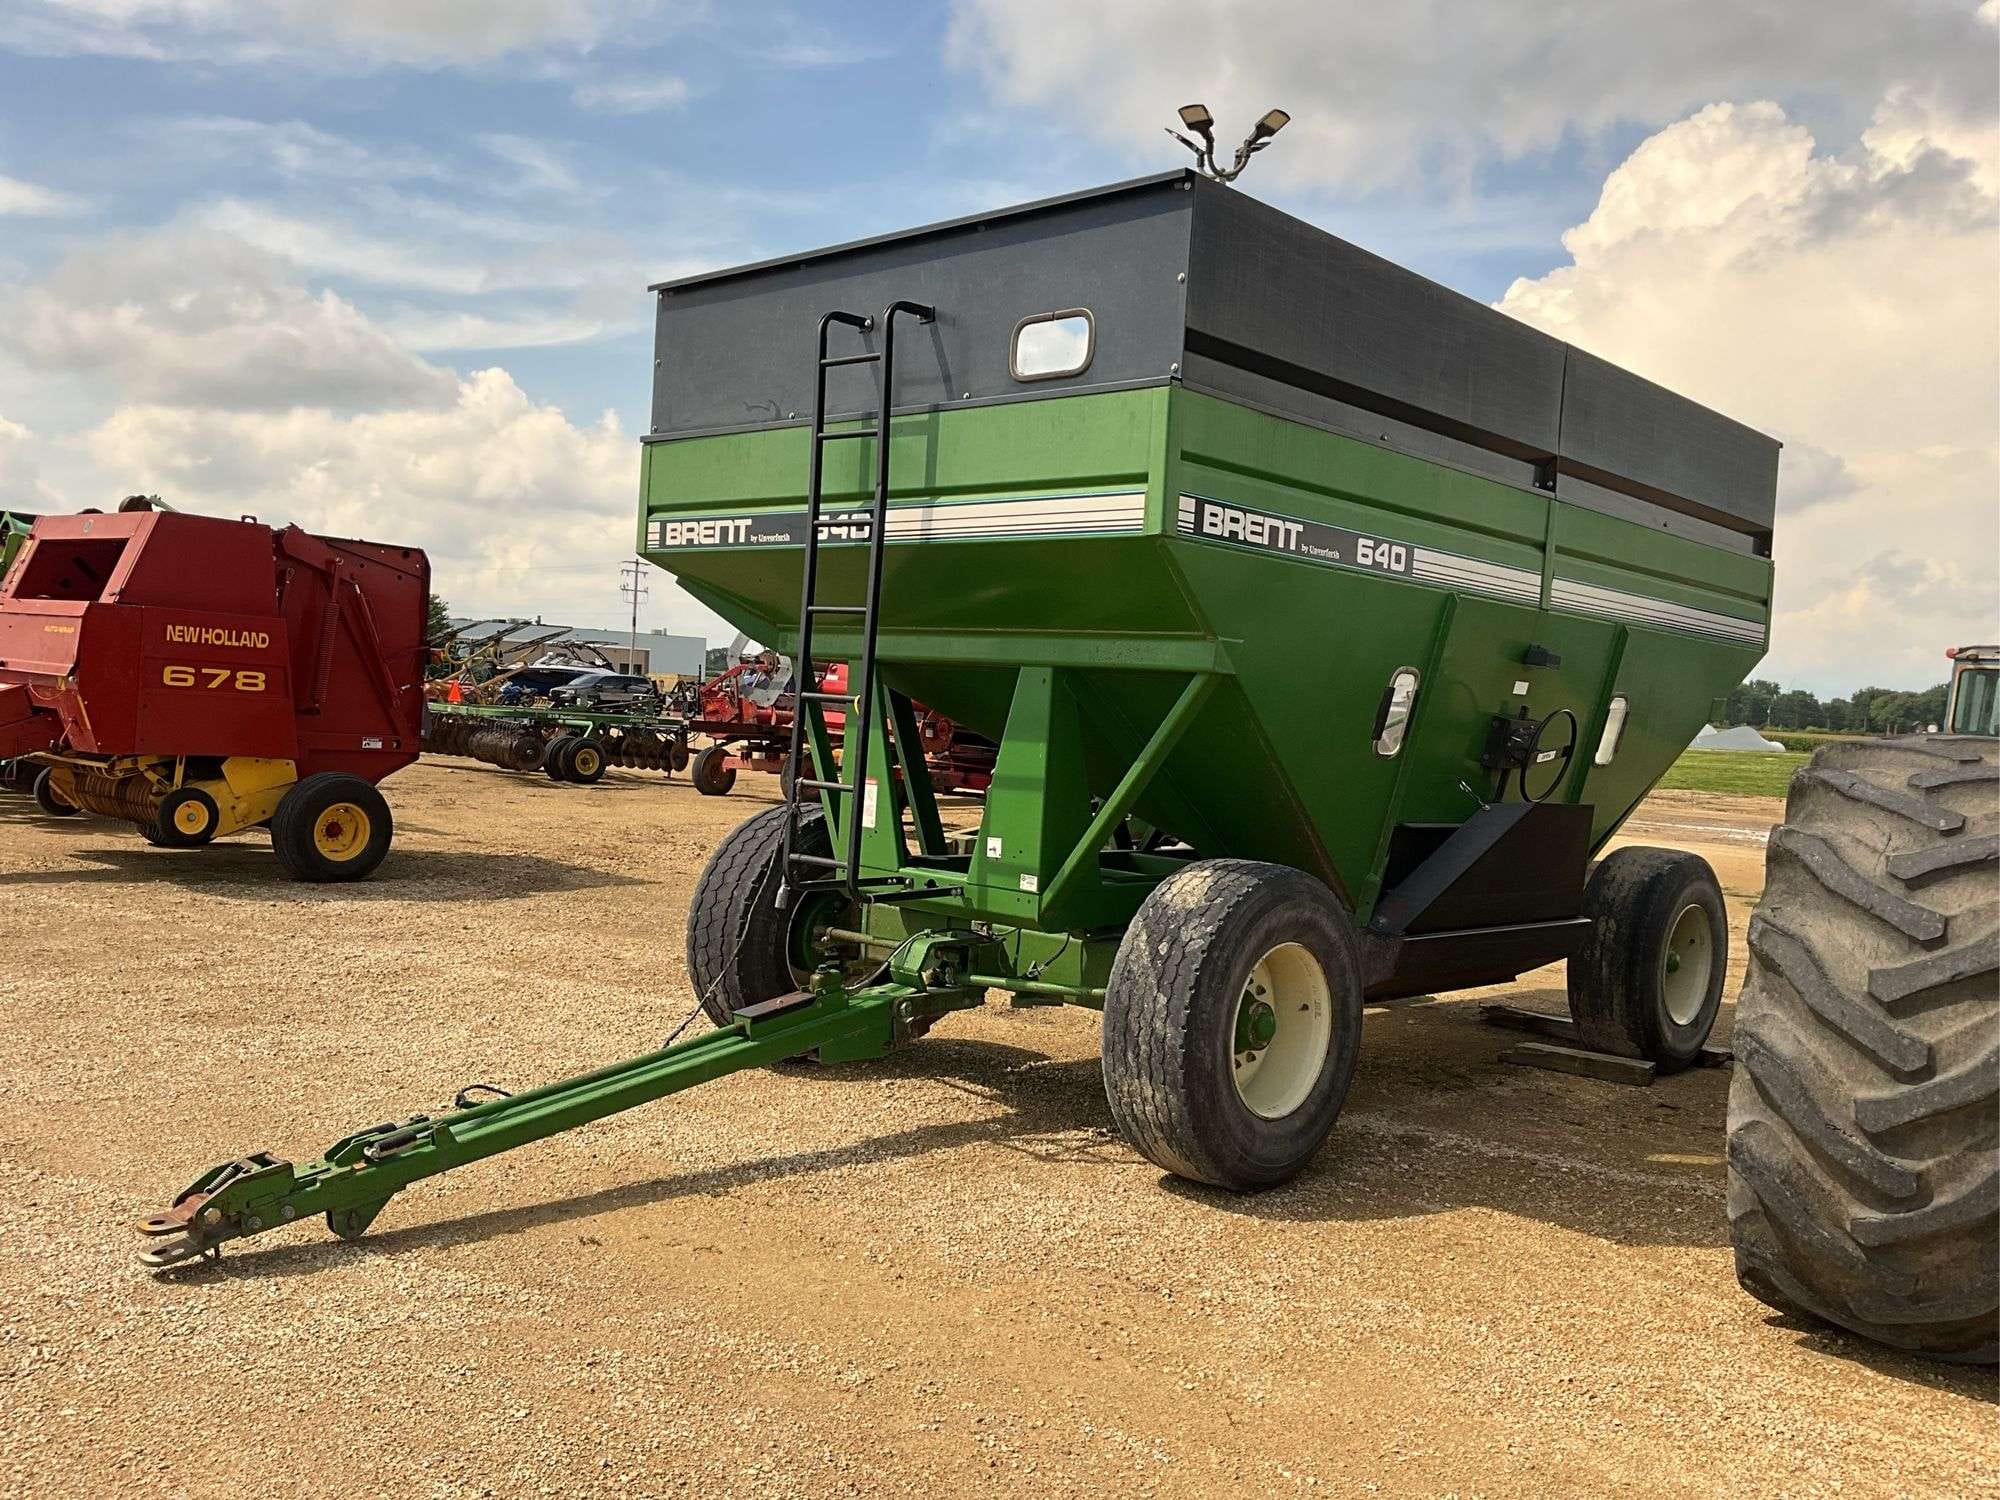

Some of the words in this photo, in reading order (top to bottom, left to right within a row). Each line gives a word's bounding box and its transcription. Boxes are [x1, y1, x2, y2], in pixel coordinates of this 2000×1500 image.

[665, 518, 752, 545] BRENT
[750, 534, 758, 544] by
[1203, 503, 1304, 551] BRENT
[1301, 543, 1309, 554] by
[1356, 537, 1406, 572] 640
[166, 624, 200, 643] NEW
[201, 627, 270, 649] HOLLAND
[163, 665, 266, 691] 678
